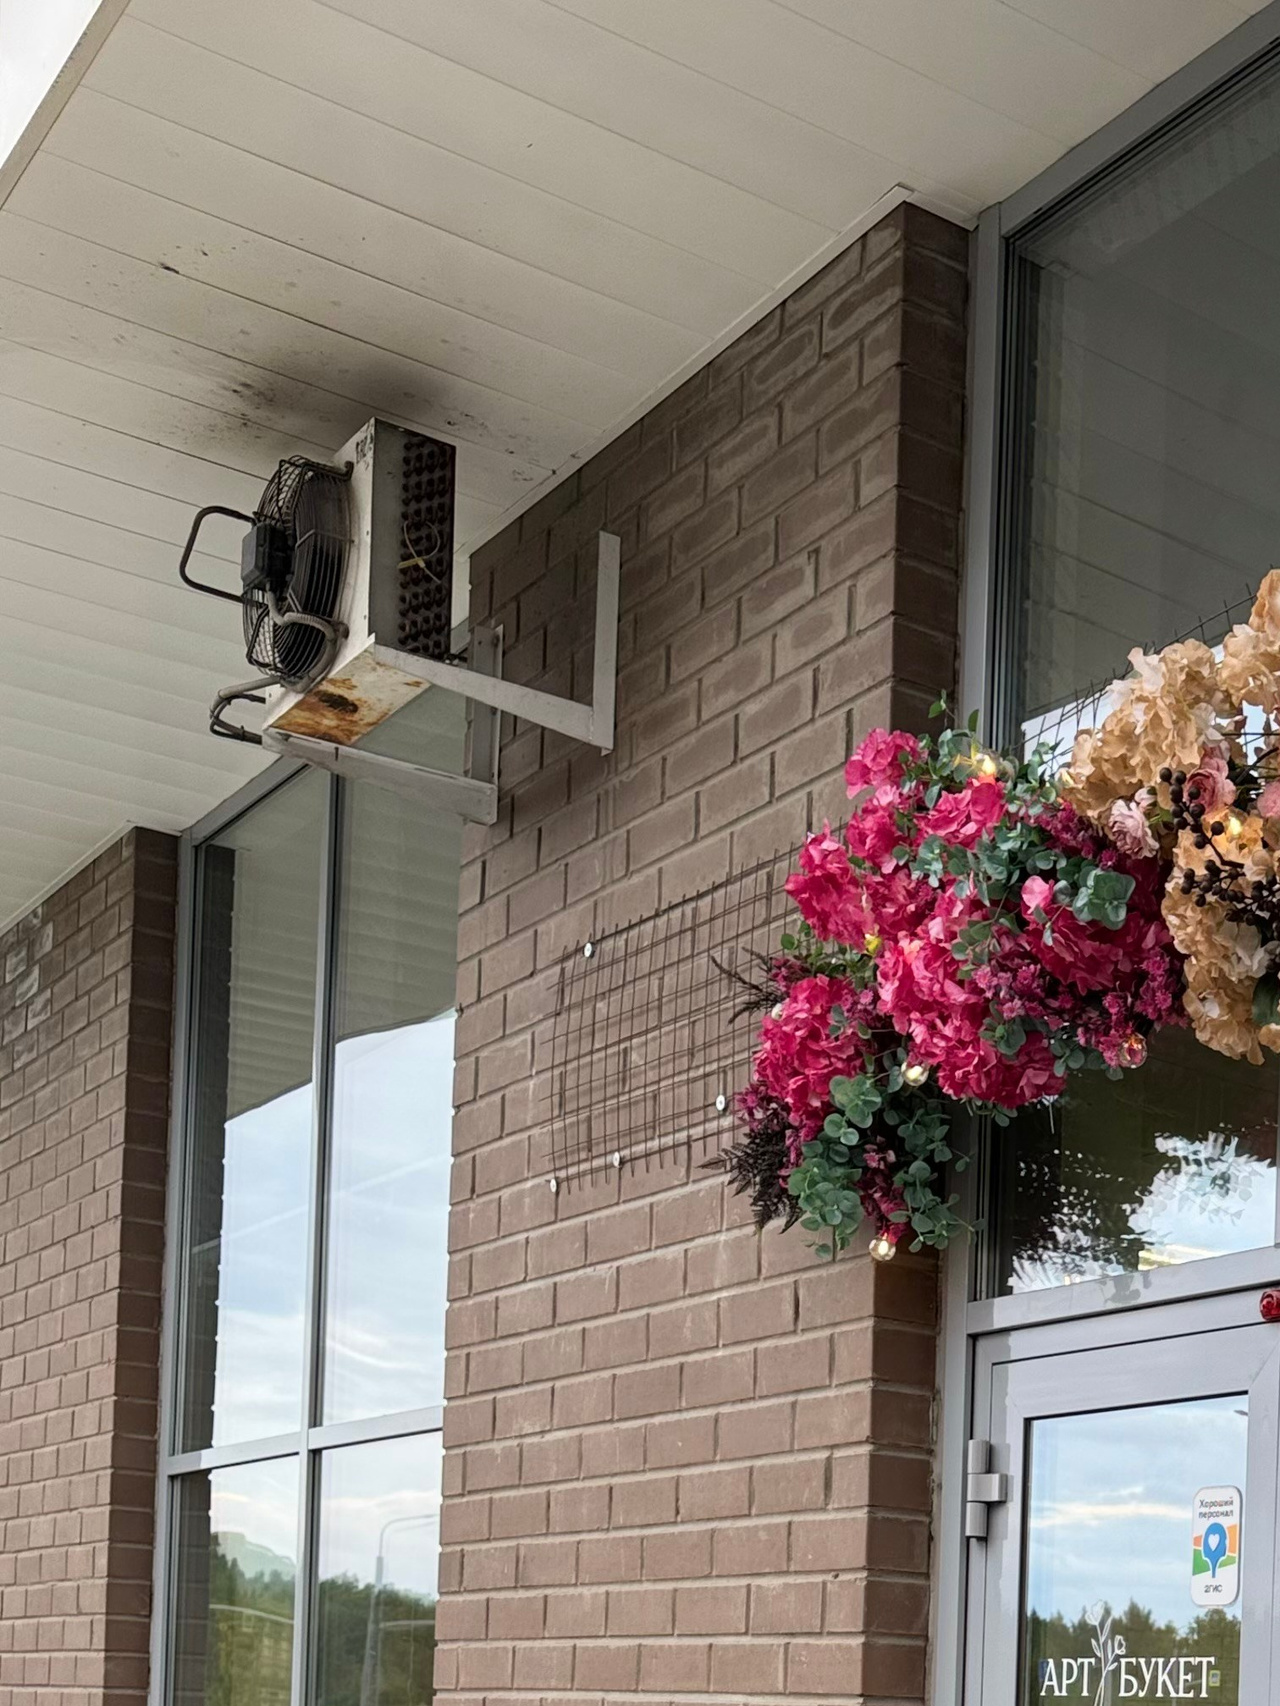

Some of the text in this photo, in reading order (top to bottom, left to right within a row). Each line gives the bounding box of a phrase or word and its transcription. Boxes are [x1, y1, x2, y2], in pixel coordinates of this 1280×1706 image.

[1199, 1497, 1234, 1509] Хороший
[1199, 1509, 1234, 1520] персонал
[1204, 1584, 1223, 1593] 2ГИС
[1040, 1656, 1215, 1698] АРТ БУКЕТ
